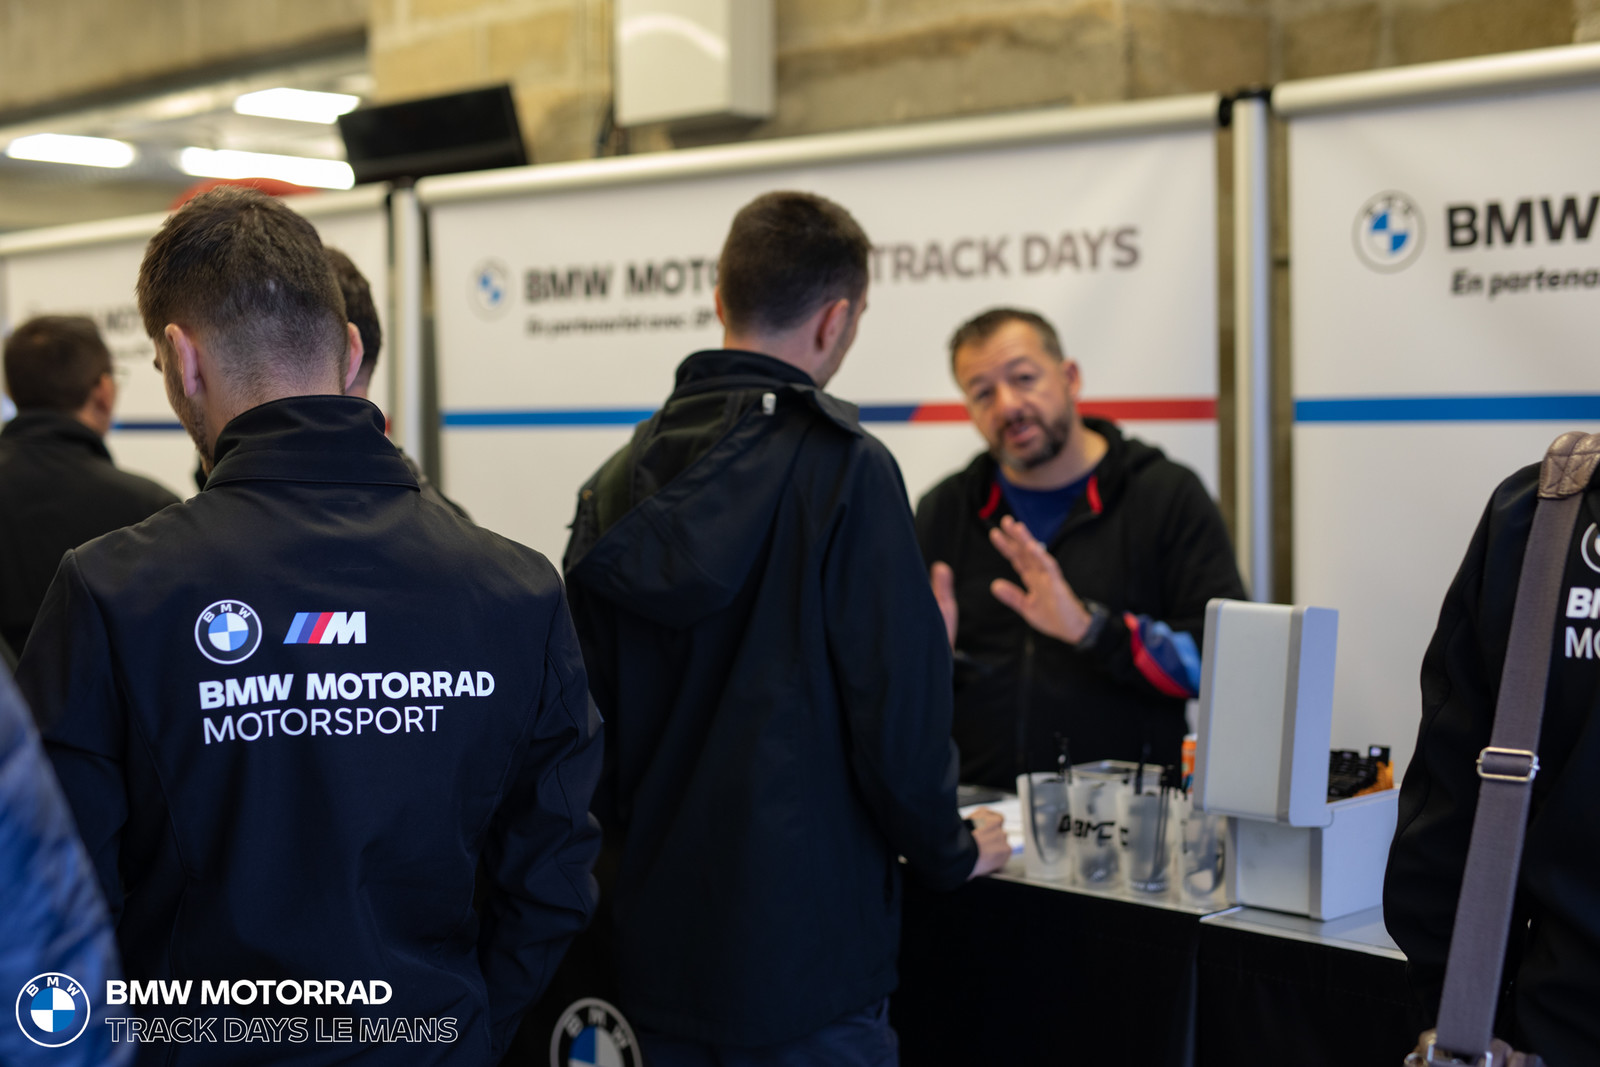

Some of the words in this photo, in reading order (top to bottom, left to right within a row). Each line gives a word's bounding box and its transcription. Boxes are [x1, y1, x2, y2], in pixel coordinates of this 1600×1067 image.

[1447, 196, 1600, 249] BMW
[524, 267, 613, 302] BMW
[868, 236, 1008, 281] TRACK
[1023, 227, 1140, 274] DAYS
[1452, 268, 1483, 294] En
[203, 603, 252, 624] BMW
[199, 674, 294, 709] BMW
[306, 671, 495, 700] MOTORRAD
[203, 705, 444, 744] MOTORSPORT
